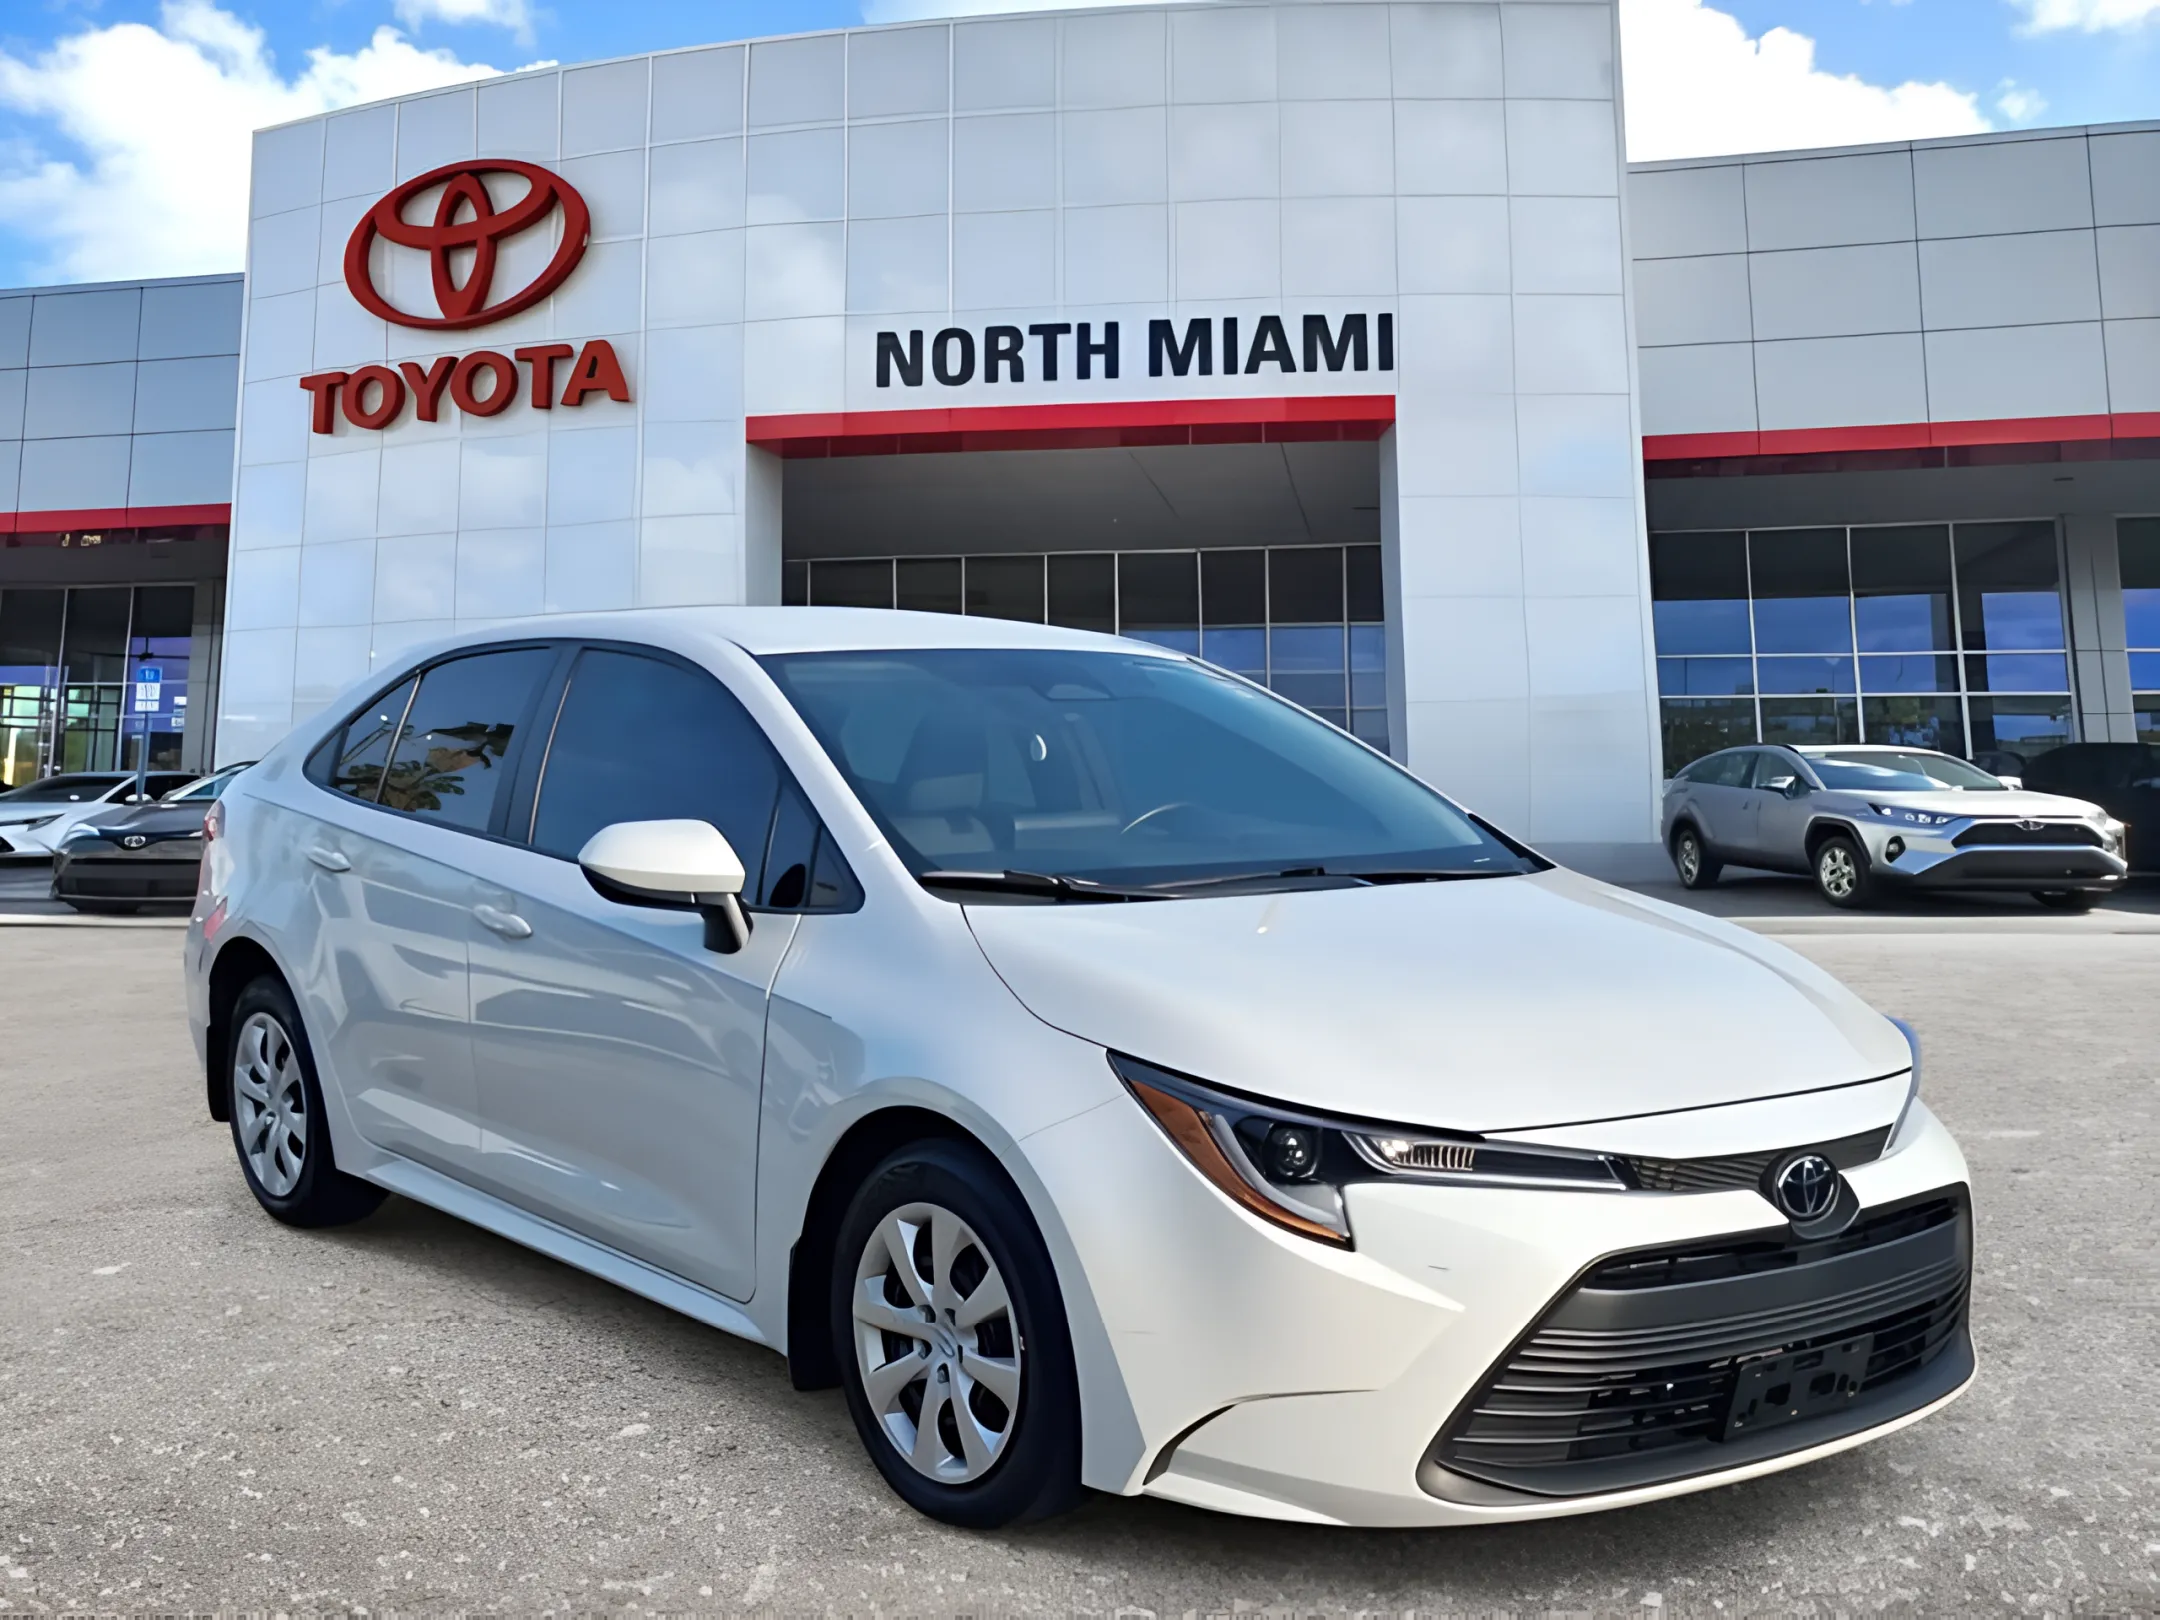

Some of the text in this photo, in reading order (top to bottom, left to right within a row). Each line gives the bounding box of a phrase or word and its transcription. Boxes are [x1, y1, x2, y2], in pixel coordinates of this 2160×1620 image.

[301, 340, 629, 433] TOYOTA
[877, 313, 1393, 387] NORTH MIAMI
